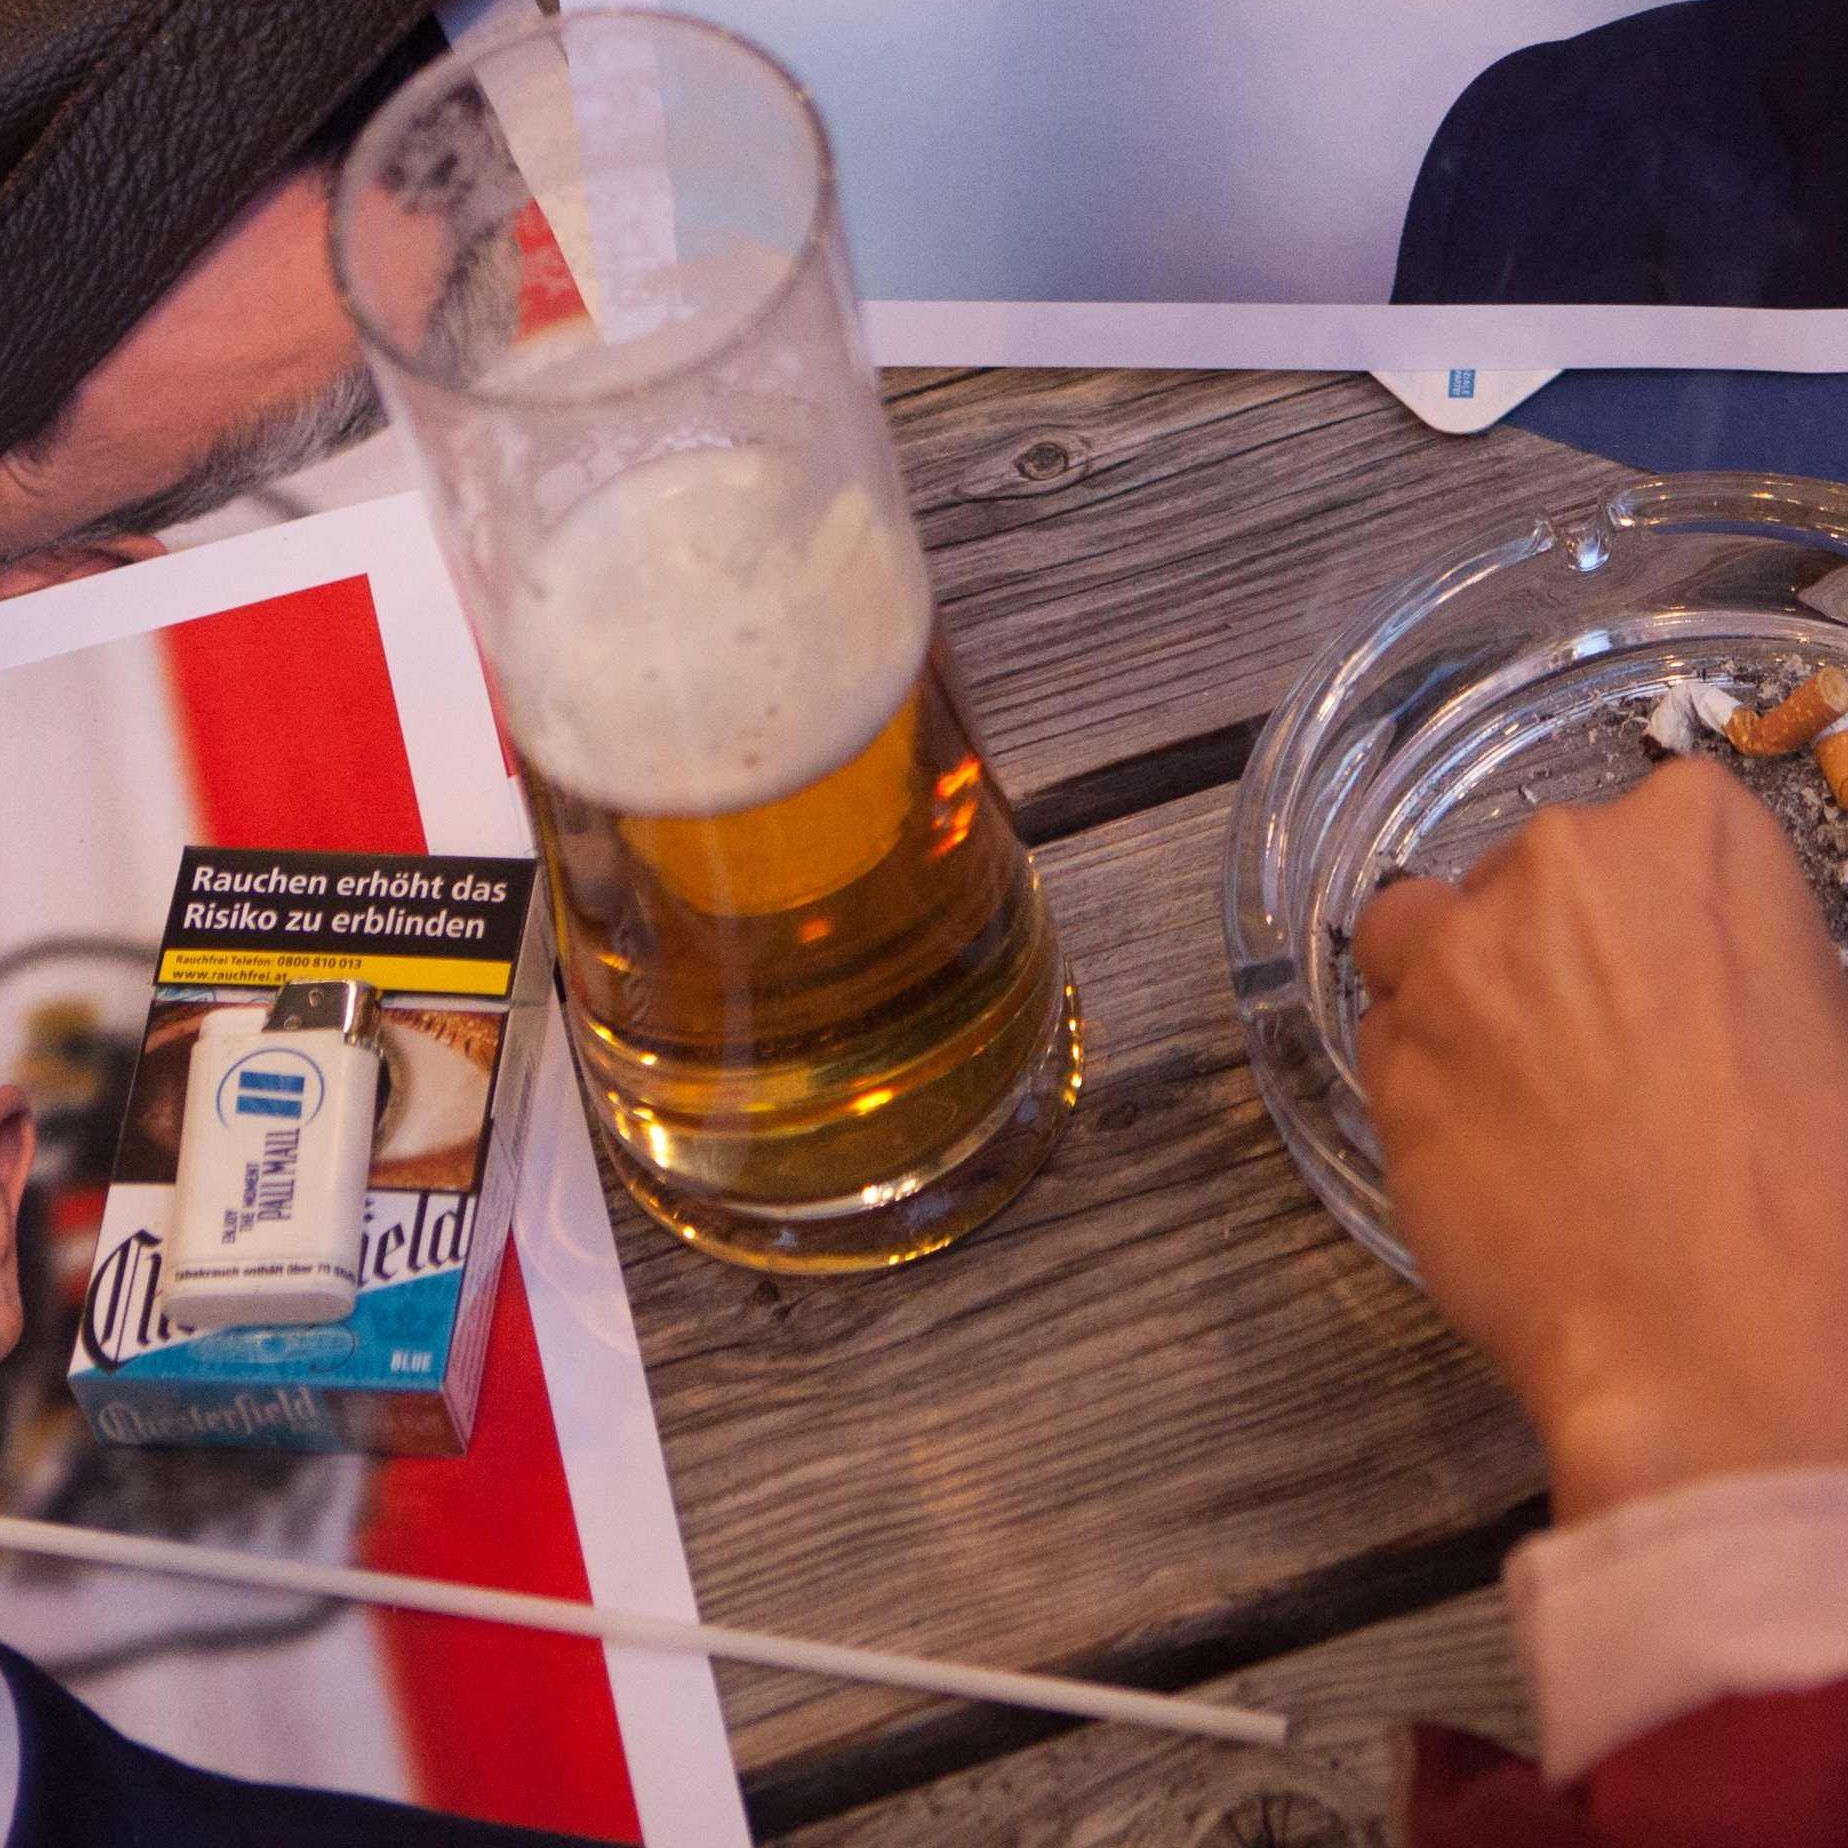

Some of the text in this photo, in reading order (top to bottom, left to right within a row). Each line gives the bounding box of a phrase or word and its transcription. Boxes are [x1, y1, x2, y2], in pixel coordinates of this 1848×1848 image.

[191, 866, 507, 903] Rauchen erhöht das
[183, 902, 485, 939] Risiko zu erblinden
[277, 956, 310, 969] 0800
[313, 957, 337, 969] 810
[339, 958, 362, 970] 013
[258, 1127, 300, 1221] PALL MALL
[391, 1353, 433, 1374] BLUE
